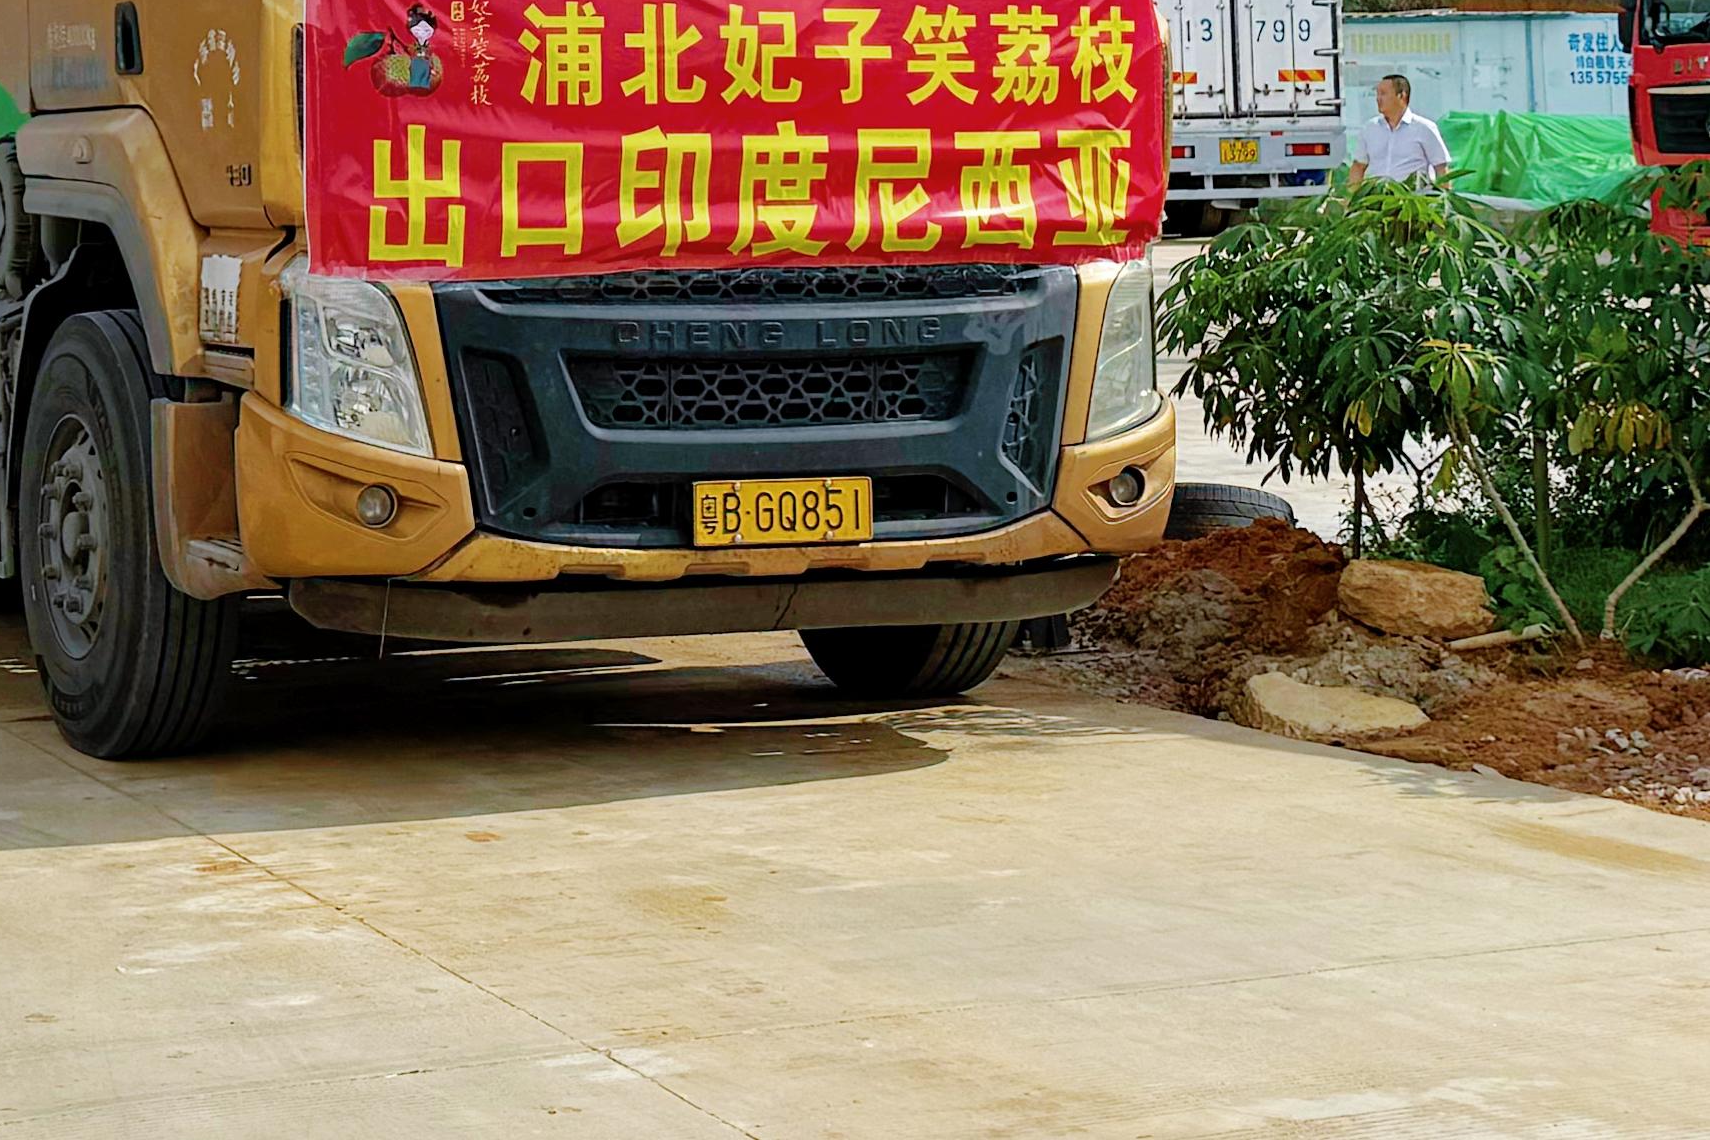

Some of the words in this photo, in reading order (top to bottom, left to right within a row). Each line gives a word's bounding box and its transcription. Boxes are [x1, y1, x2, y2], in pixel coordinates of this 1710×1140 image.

[519, 2, 1138, 108] 浦北妃子笑荔枝
[367, 121, 1132, 268] 出口印度尼西亚
[816, 317, 942, 347] LONG
